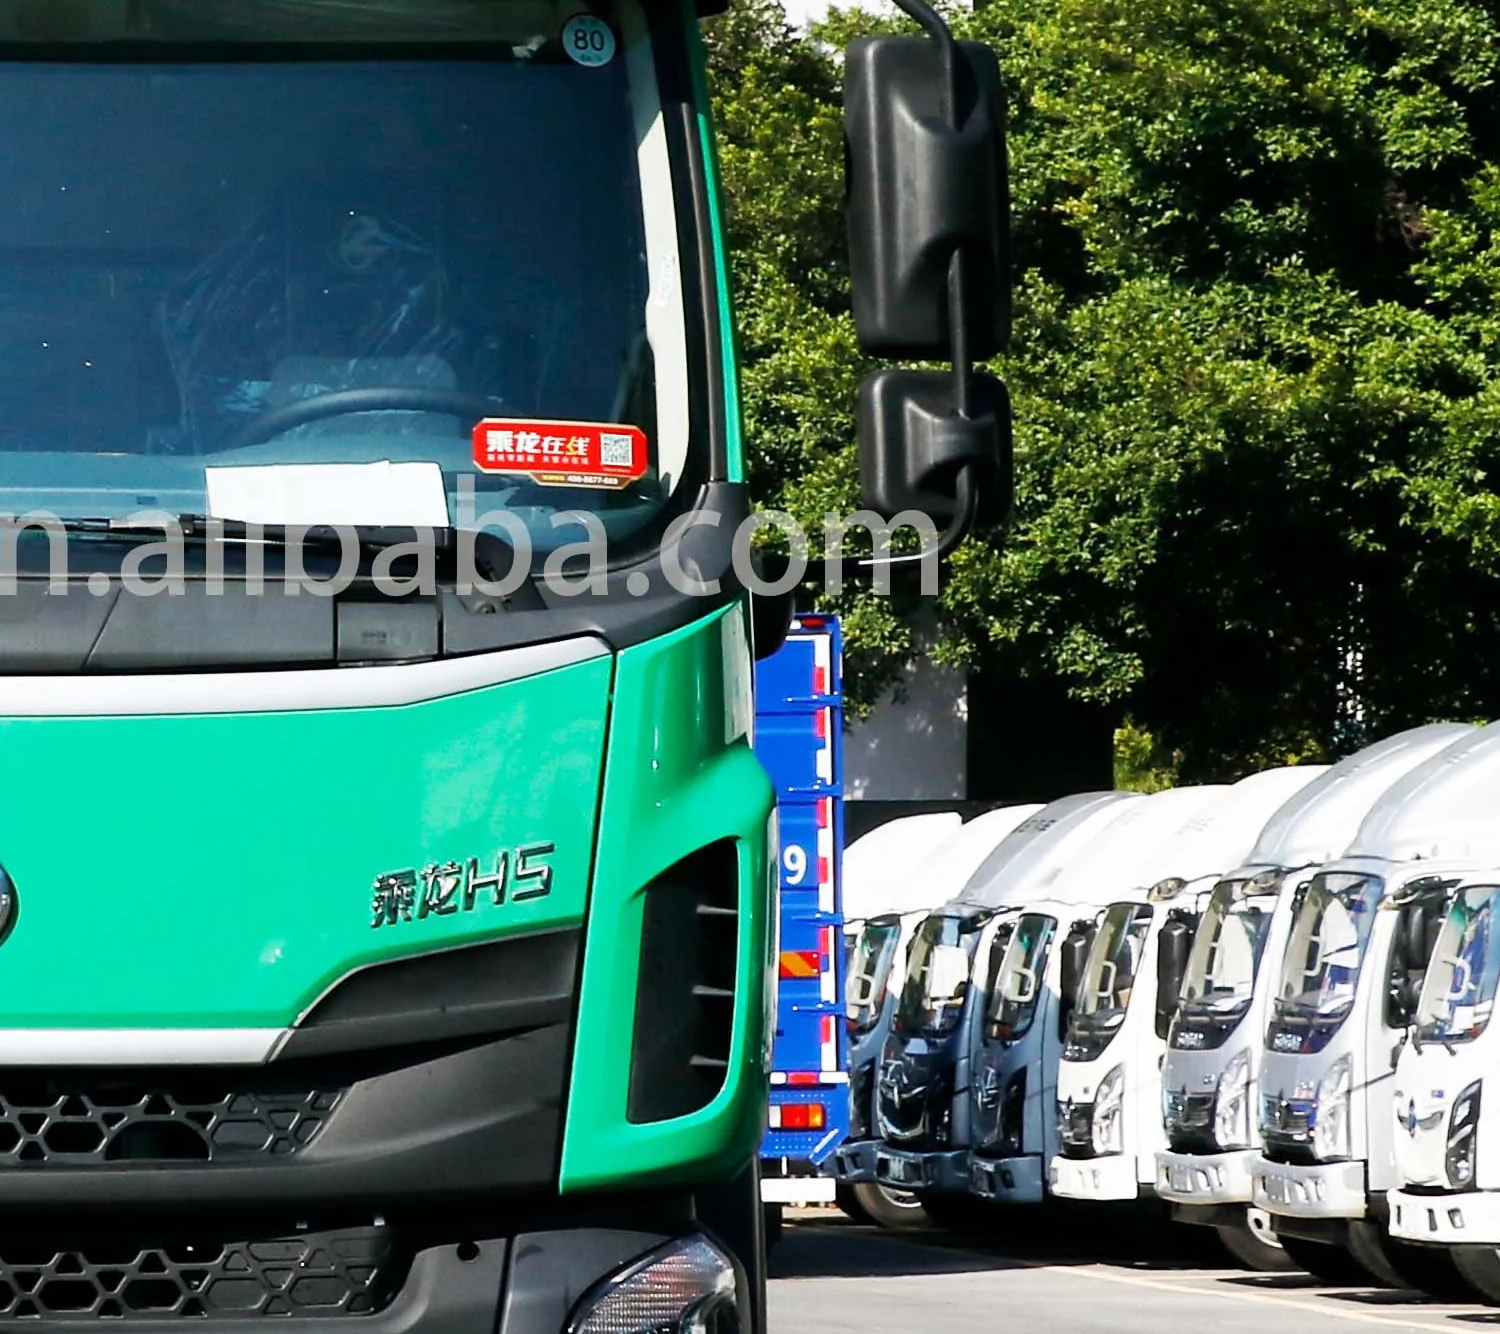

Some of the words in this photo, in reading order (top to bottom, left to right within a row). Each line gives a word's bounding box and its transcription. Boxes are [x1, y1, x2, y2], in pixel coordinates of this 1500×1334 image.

[574, 28, 605, 52] 80
[485, 429, 591, 457] 乘龙在线
[782, 844, 808, 885] 9
